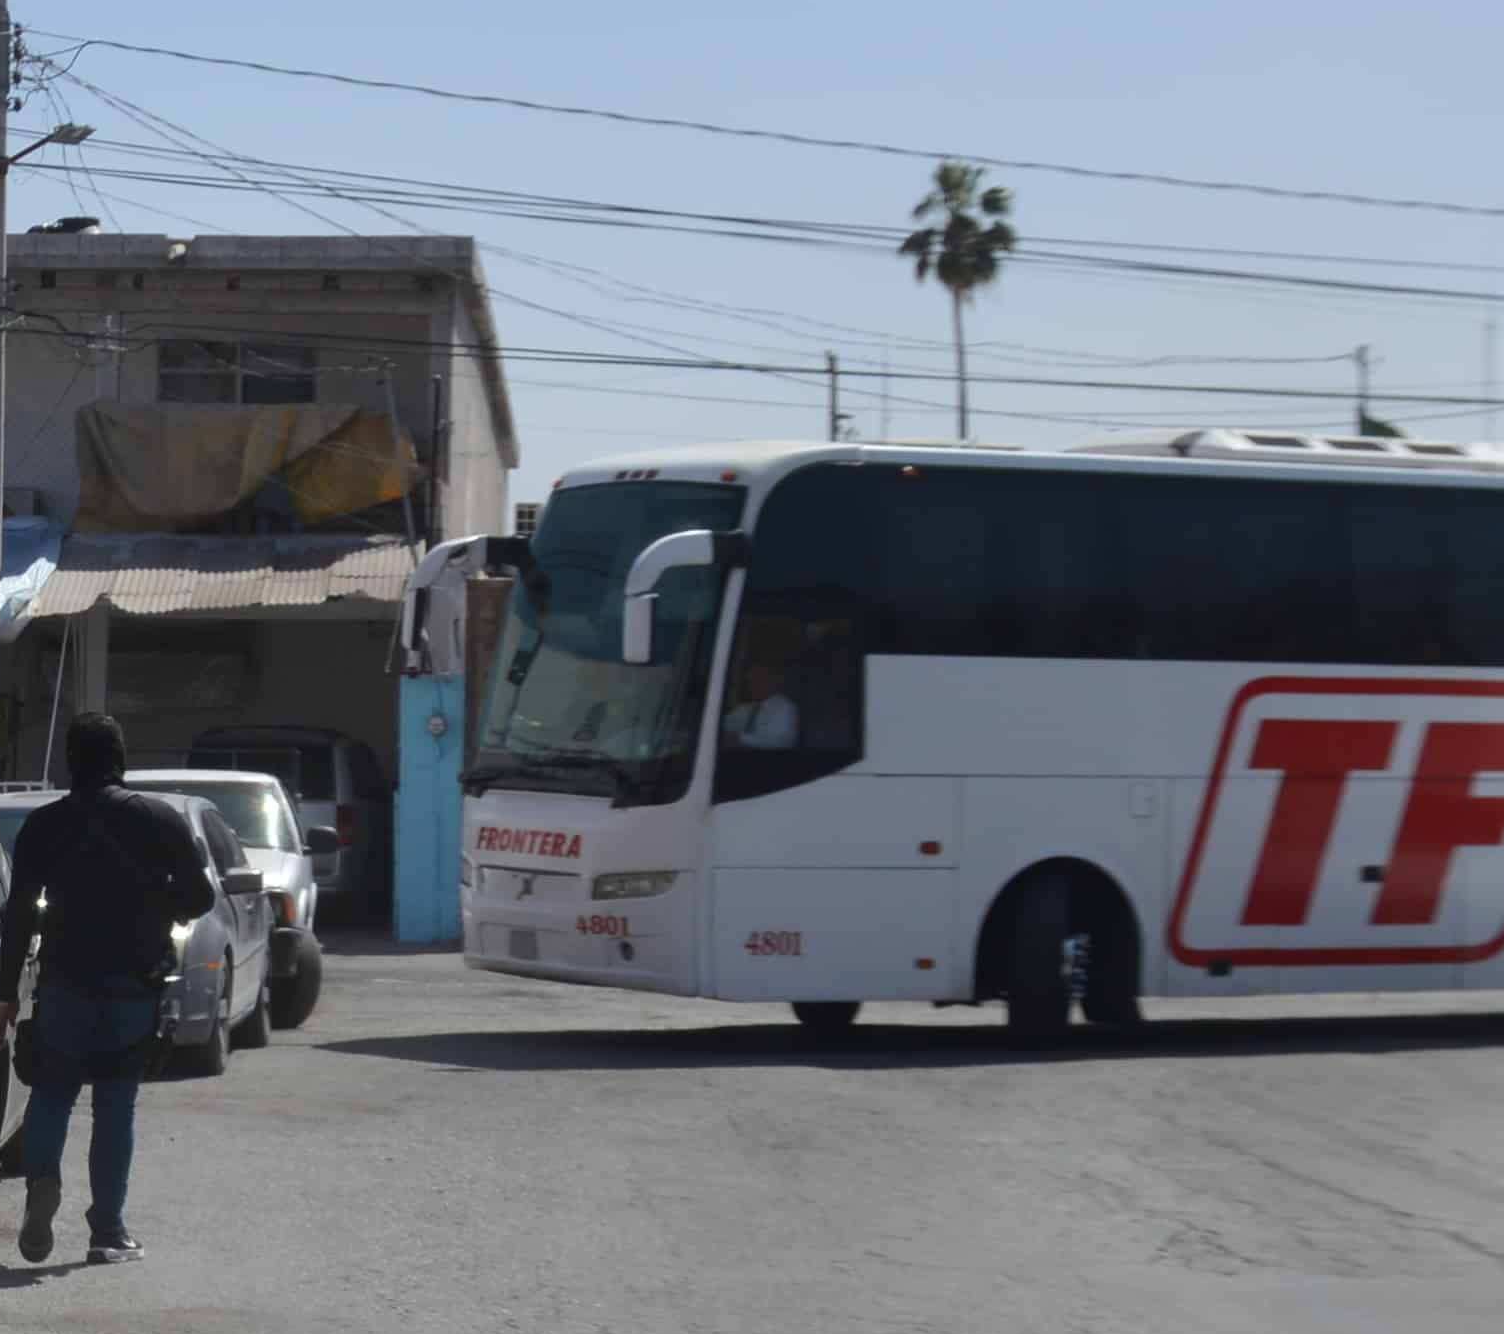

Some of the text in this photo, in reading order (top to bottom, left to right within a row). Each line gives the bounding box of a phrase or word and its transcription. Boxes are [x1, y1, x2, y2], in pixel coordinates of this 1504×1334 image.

[476, 826, 583, 859] FRONTERA
[575, 915, 630, 937] 4801
[744, 930, 804, 957] 4801
